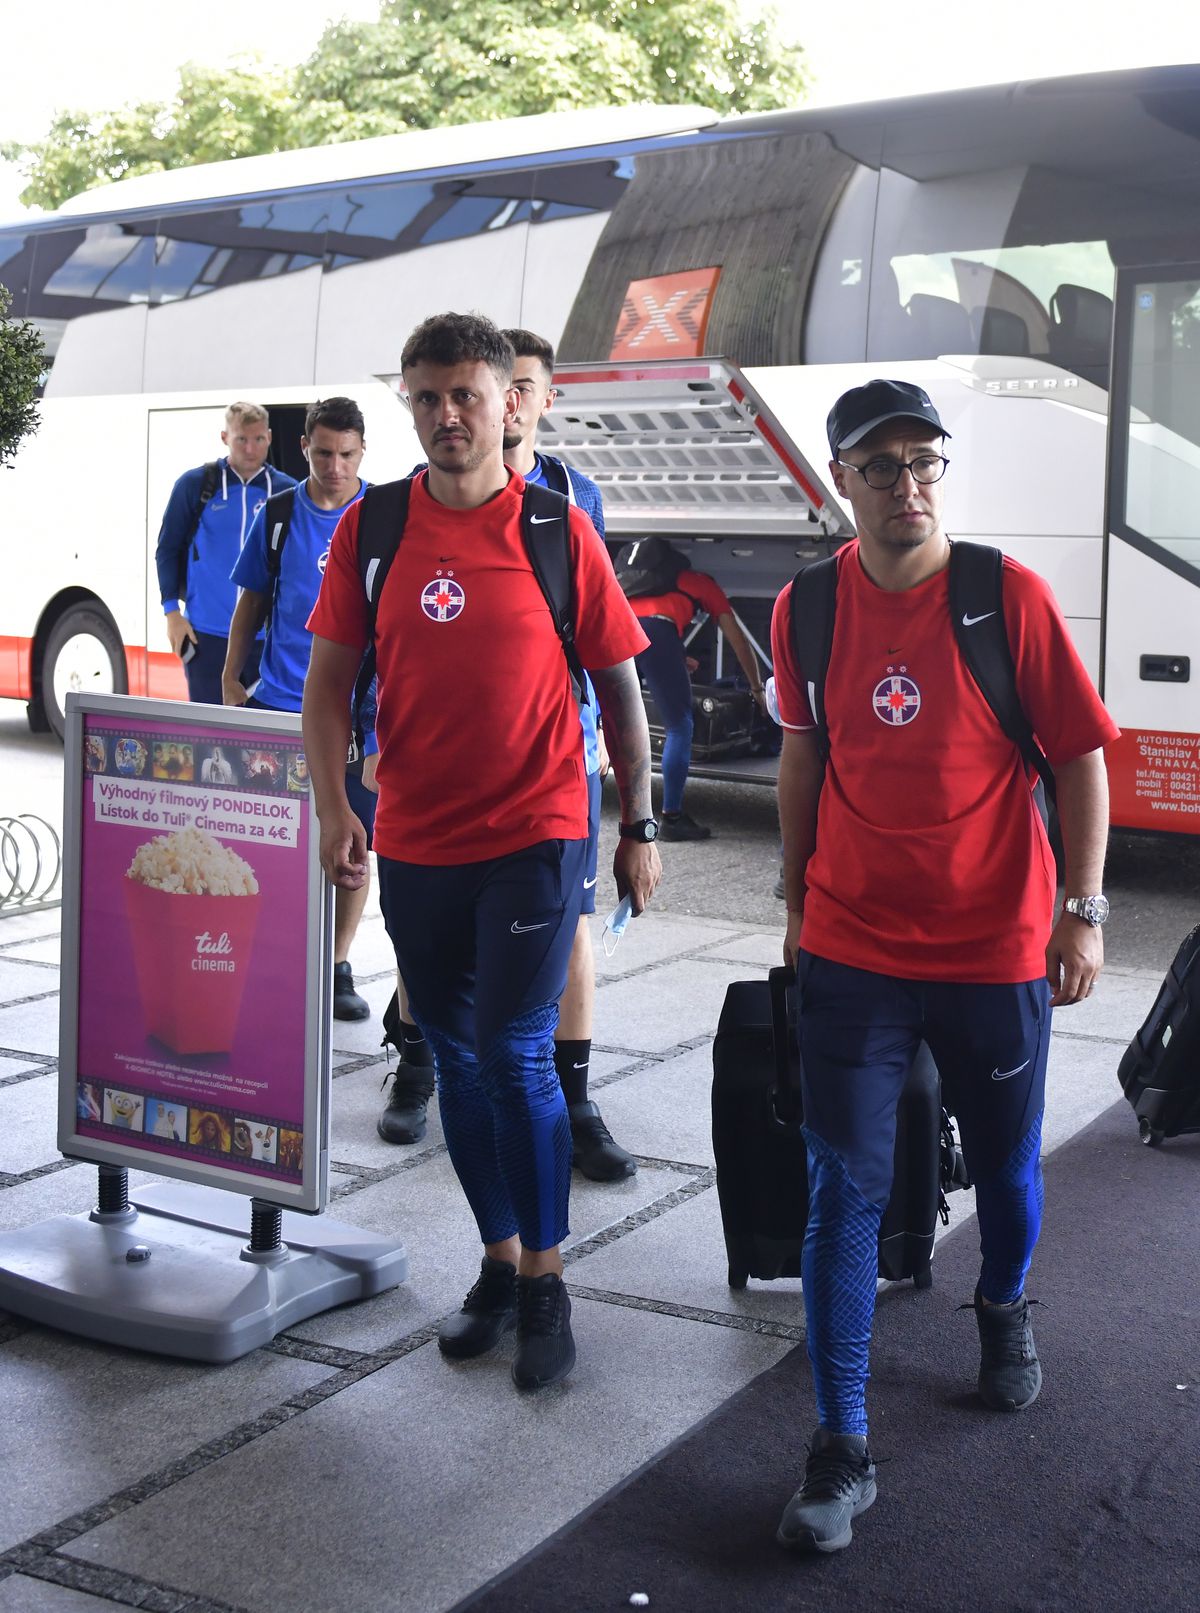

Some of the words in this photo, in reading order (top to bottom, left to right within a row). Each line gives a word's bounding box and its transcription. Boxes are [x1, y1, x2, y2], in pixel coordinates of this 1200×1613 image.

[985, 378, 1080, 391] SETRA
[1139, 744, 1192, 759] Stanislav
[1170, 771, 1196, 782] 00421
[1170, 781, 1196, 791] 00421
[99, 783, 157, 805] Výhodný
[159, 789, 209, 812] filmový
[212, 797, 294, 820] PONDELOK.
[100, 803, 139, 821] Lístok
[142, 809, 159, 823] do
[194, 815, 246, 835] Cinema
[249, 825, 265, 837] za
[268, 825, 291, 841] 4€.
[195, 931, 233, 954] tuli
[191, 955, 235, 973] cinema
